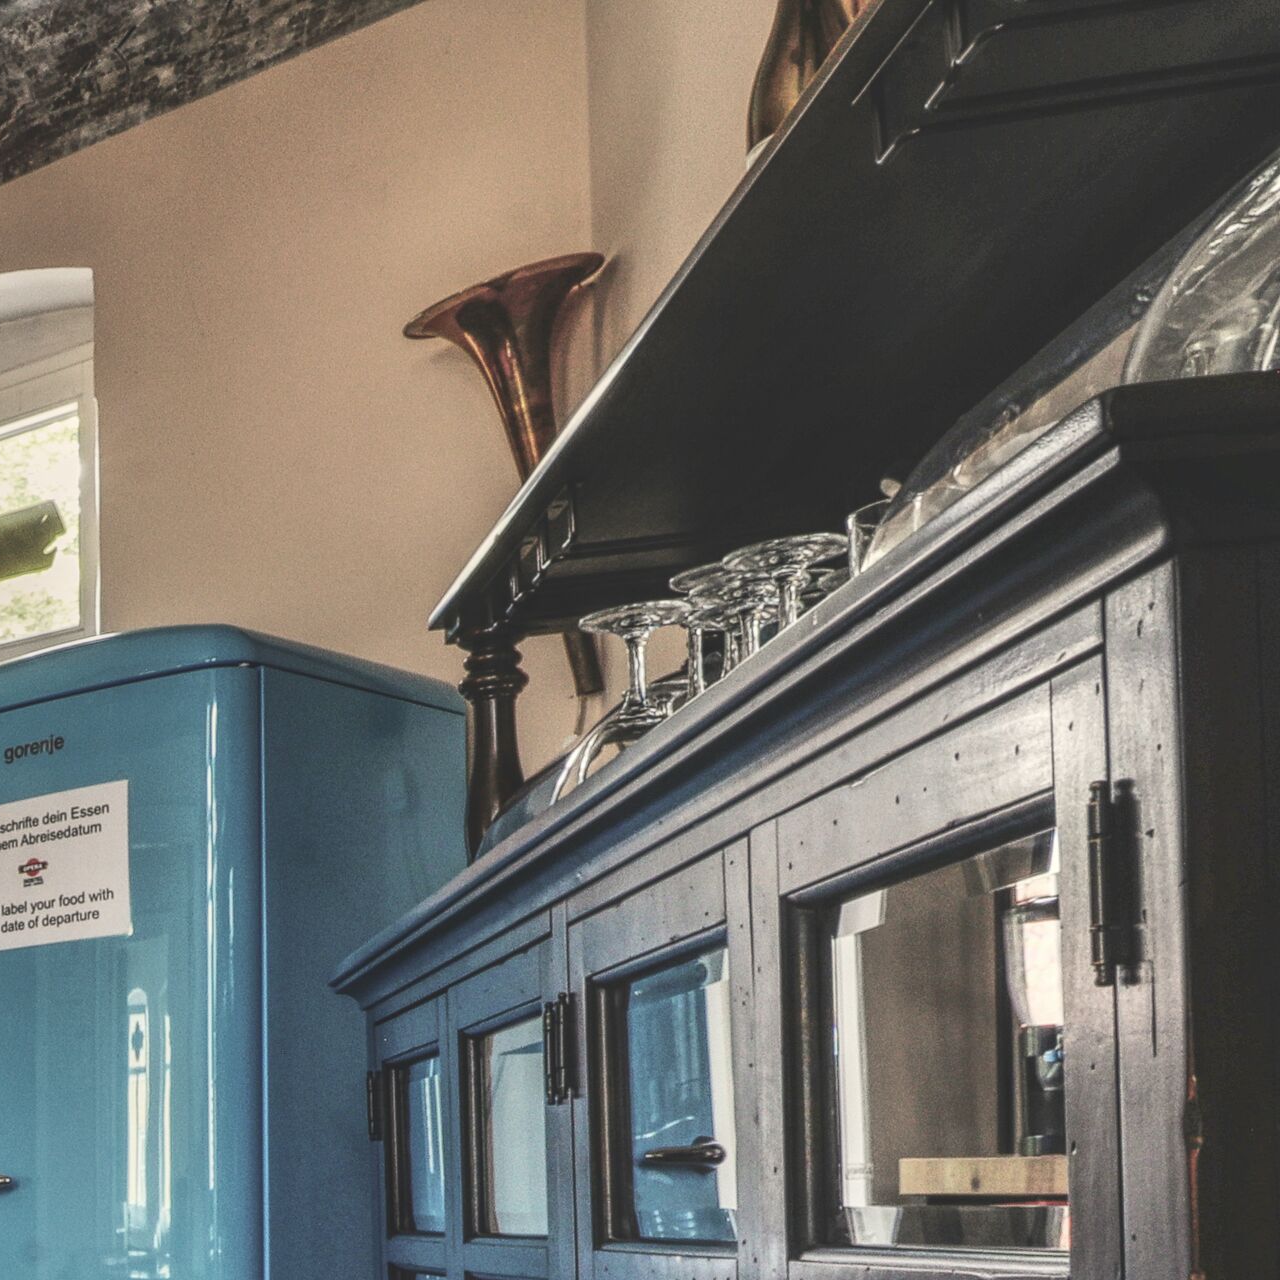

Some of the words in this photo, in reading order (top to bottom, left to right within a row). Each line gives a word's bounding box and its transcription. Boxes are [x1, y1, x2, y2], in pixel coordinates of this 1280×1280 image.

[4, 734, 65, 764] gorenje
[42, 811, 67, 825] dein
[71, 803, 110, 820] Essen
[20, 823, 102, 847] Abreisedatum
[1, 901, 28, 916] label
[30, 898, 55, 915] your
[59, 891, 86, 907] food
[88, 888, 114, 902] with
[1, 917, 25, 933] date
[28, 913, 40, 929] of
[41, 909, 100, 928] departure
